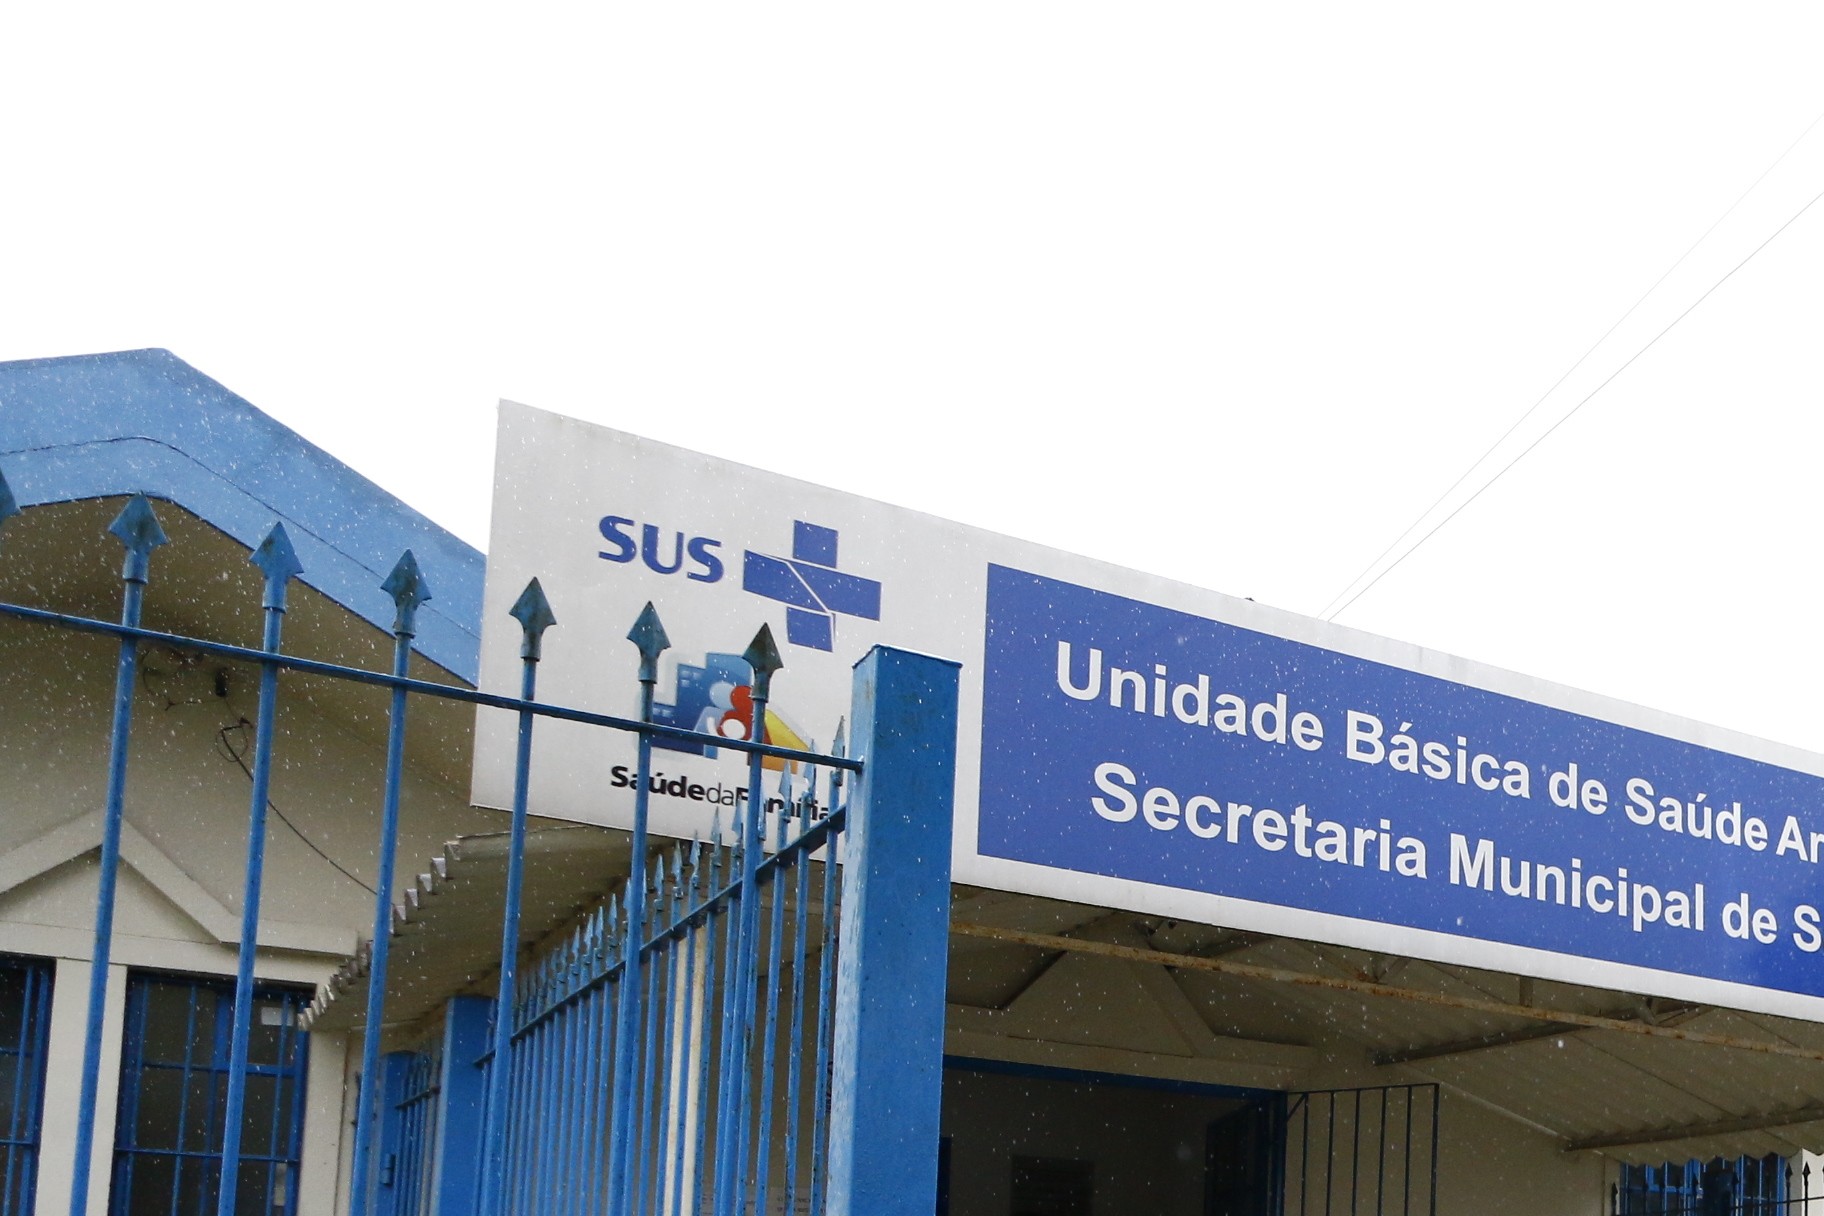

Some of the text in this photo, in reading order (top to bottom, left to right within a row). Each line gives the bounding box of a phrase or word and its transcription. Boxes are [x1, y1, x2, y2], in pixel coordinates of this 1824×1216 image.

[598, 515, 726, 584] SUS
[1057, 641, 1325, 751] Unidade
[1346, 709, 1531, 799] Básica
[1548, 762, 1609, 815] de
[1624, 777, 1769, 852] Saúde
[1091, 762, 1427, 880] Secretaria
[1449, 832, 1705, 933] Municipal
[1722, 893, 1778, 945] de
